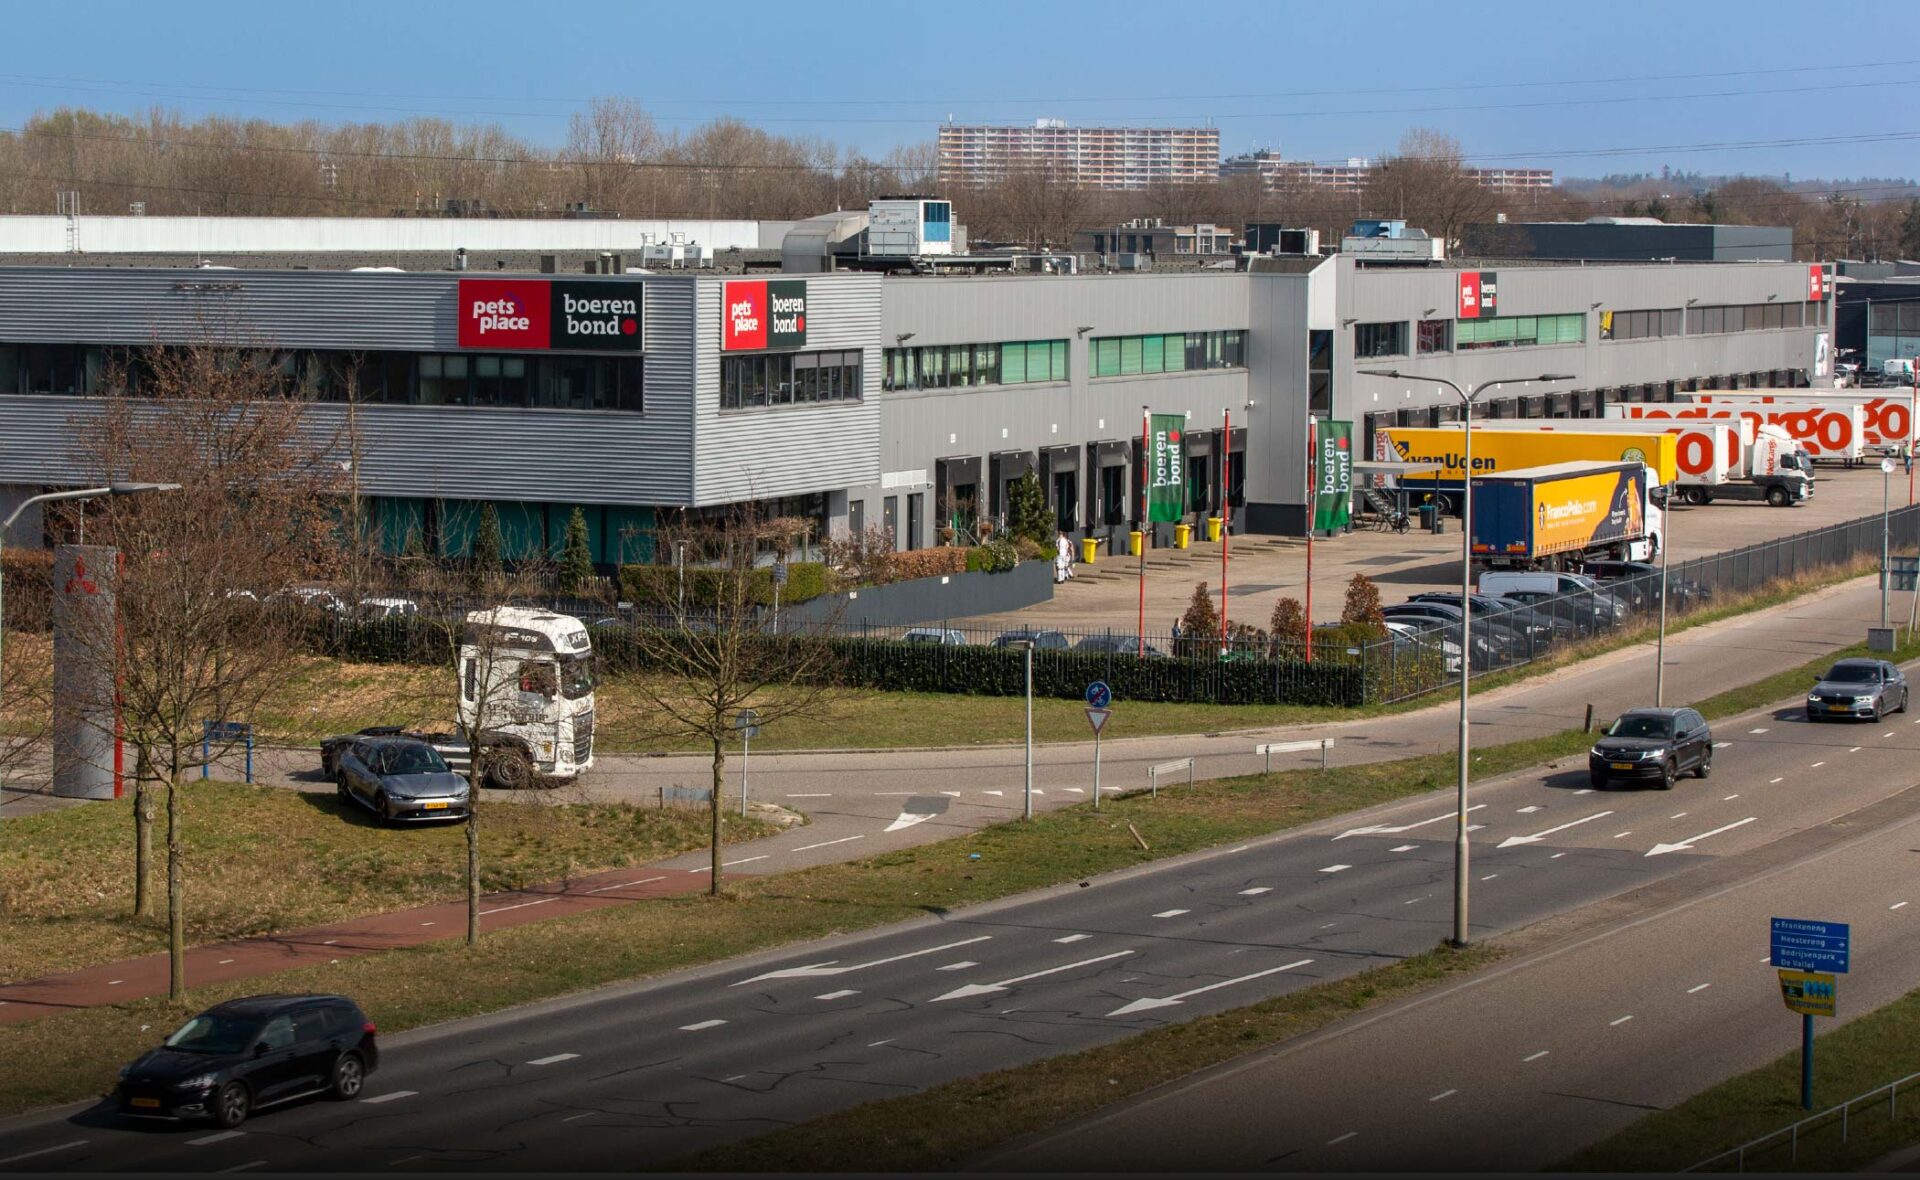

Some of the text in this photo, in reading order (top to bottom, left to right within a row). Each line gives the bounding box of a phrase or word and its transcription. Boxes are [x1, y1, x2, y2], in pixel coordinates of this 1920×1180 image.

[473, 298, 515, 318] pets
[563, 293, 637, 314] boeren
[731, 300, 752, 321] pets
[772, 293, 804, 313] boeren
[479, 314, 530, 334] place
[566, 315, 620, 335] bond
[734, 316, 758, 336] place
[773, 313, 797, 333] bond
[1153, 431, 1166, 487] boeren
[1168, 444, 1181, 486] bond
[1320, 437, 1335, 496] boeren
[1336, 451, 1350, 493] bond
